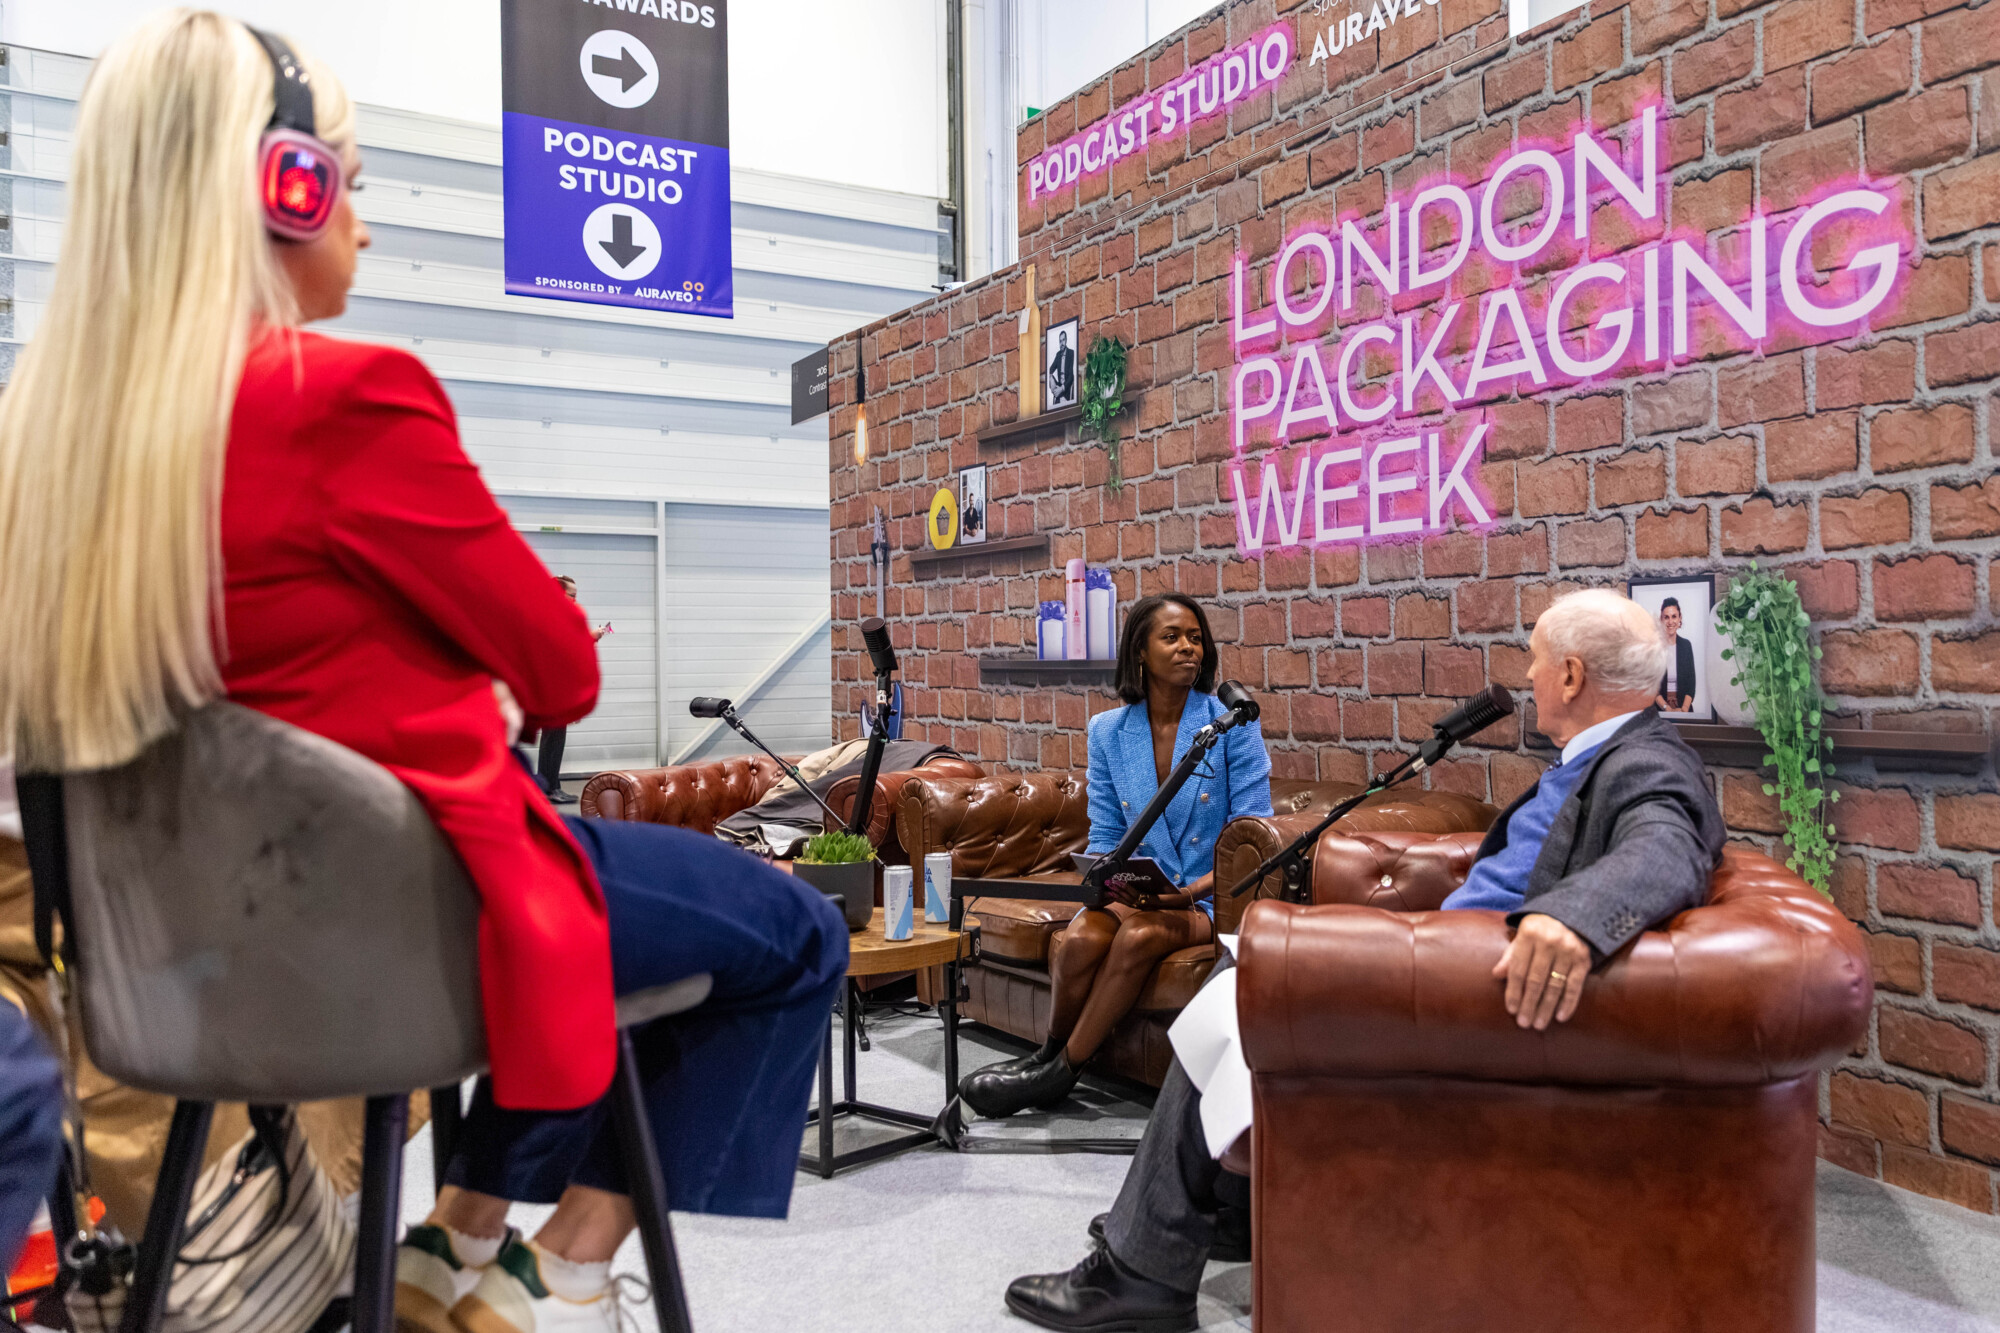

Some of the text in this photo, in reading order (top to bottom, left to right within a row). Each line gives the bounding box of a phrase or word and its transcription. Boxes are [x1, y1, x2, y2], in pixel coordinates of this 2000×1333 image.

[1314, 0, 1343, 16] Spo
[544, 127, 697, 174] PODCAST
[1030, 32, 1288, 200] PODCAST STUDIO
[559, 164, 683, 204] STUDIO
[1235, 106, 1656, 342] LONDON
[535, 277, 693, 302] SPONSORED BY AURAVEO
[1235, 190, 1899, 446] PACKAGING
[1233, 424, 1492, 550] WEEK
